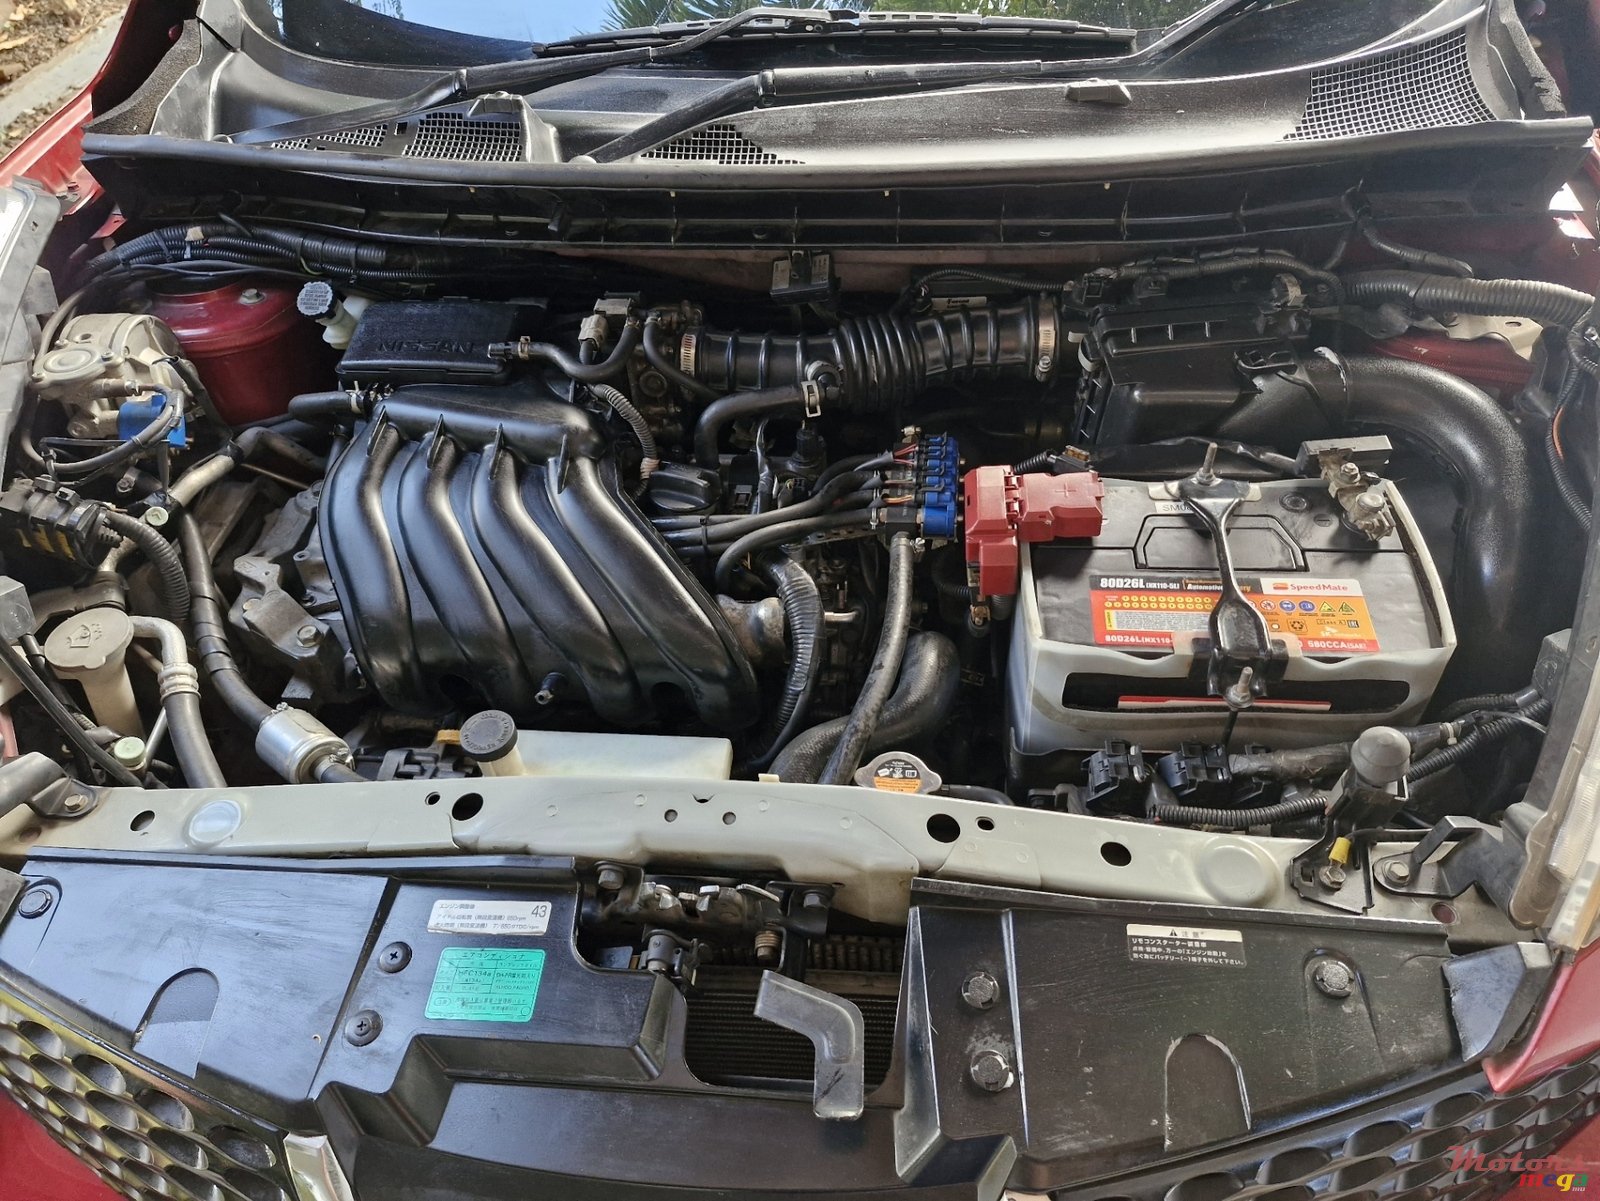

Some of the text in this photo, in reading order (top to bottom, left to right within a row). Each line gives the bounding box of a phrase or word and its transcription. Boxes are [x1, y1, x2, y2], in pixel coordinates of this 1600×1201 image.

[378, 340, 475, 353] NISSAN
[1100, 577, 1146, 589] 80D26L
[1290, 583, 1348, 591] SpeedMate
[1105, 634, 1173, 644] 80D26L(NX110-
[531, 904, 548, 918] 43
